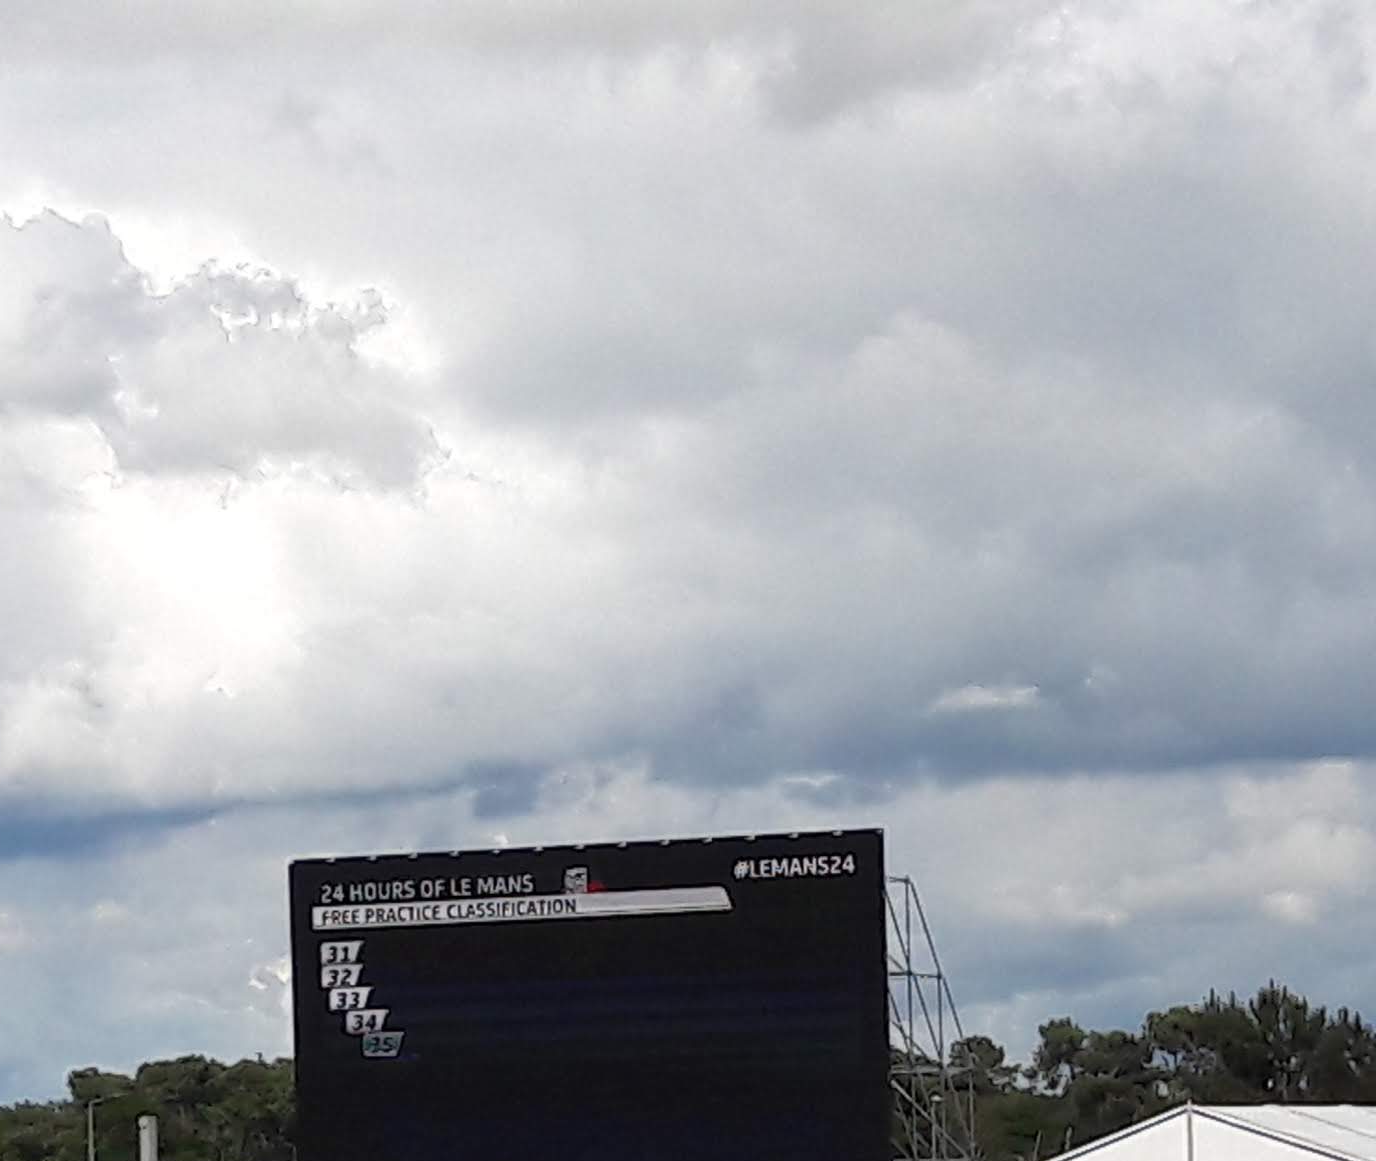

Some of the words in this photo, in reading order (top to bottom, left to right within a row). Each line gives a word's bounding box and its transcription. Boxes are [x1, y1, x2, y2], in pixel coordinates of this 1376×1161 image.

[734, 854, 855, 879] #LEMANS24
[321, 884, 344, 904] 24
[349, 879, 416, 901] HOURS
[420, 879, 445, 898] OF
[450, 877, 473, 896] LE
[477, 874, 534, 894] MANS
[321, 909, 360, 926] FREE
[365, 904, 440, 924] PRACTICE
[446, 898, 576, 920] CLASSIFICATION
[326, 946, 351, 963] 31
[327, 969, 352, 986] 32
[336, 992, 360, 1009] 33
[352, 1014, 377, 1031] 34
